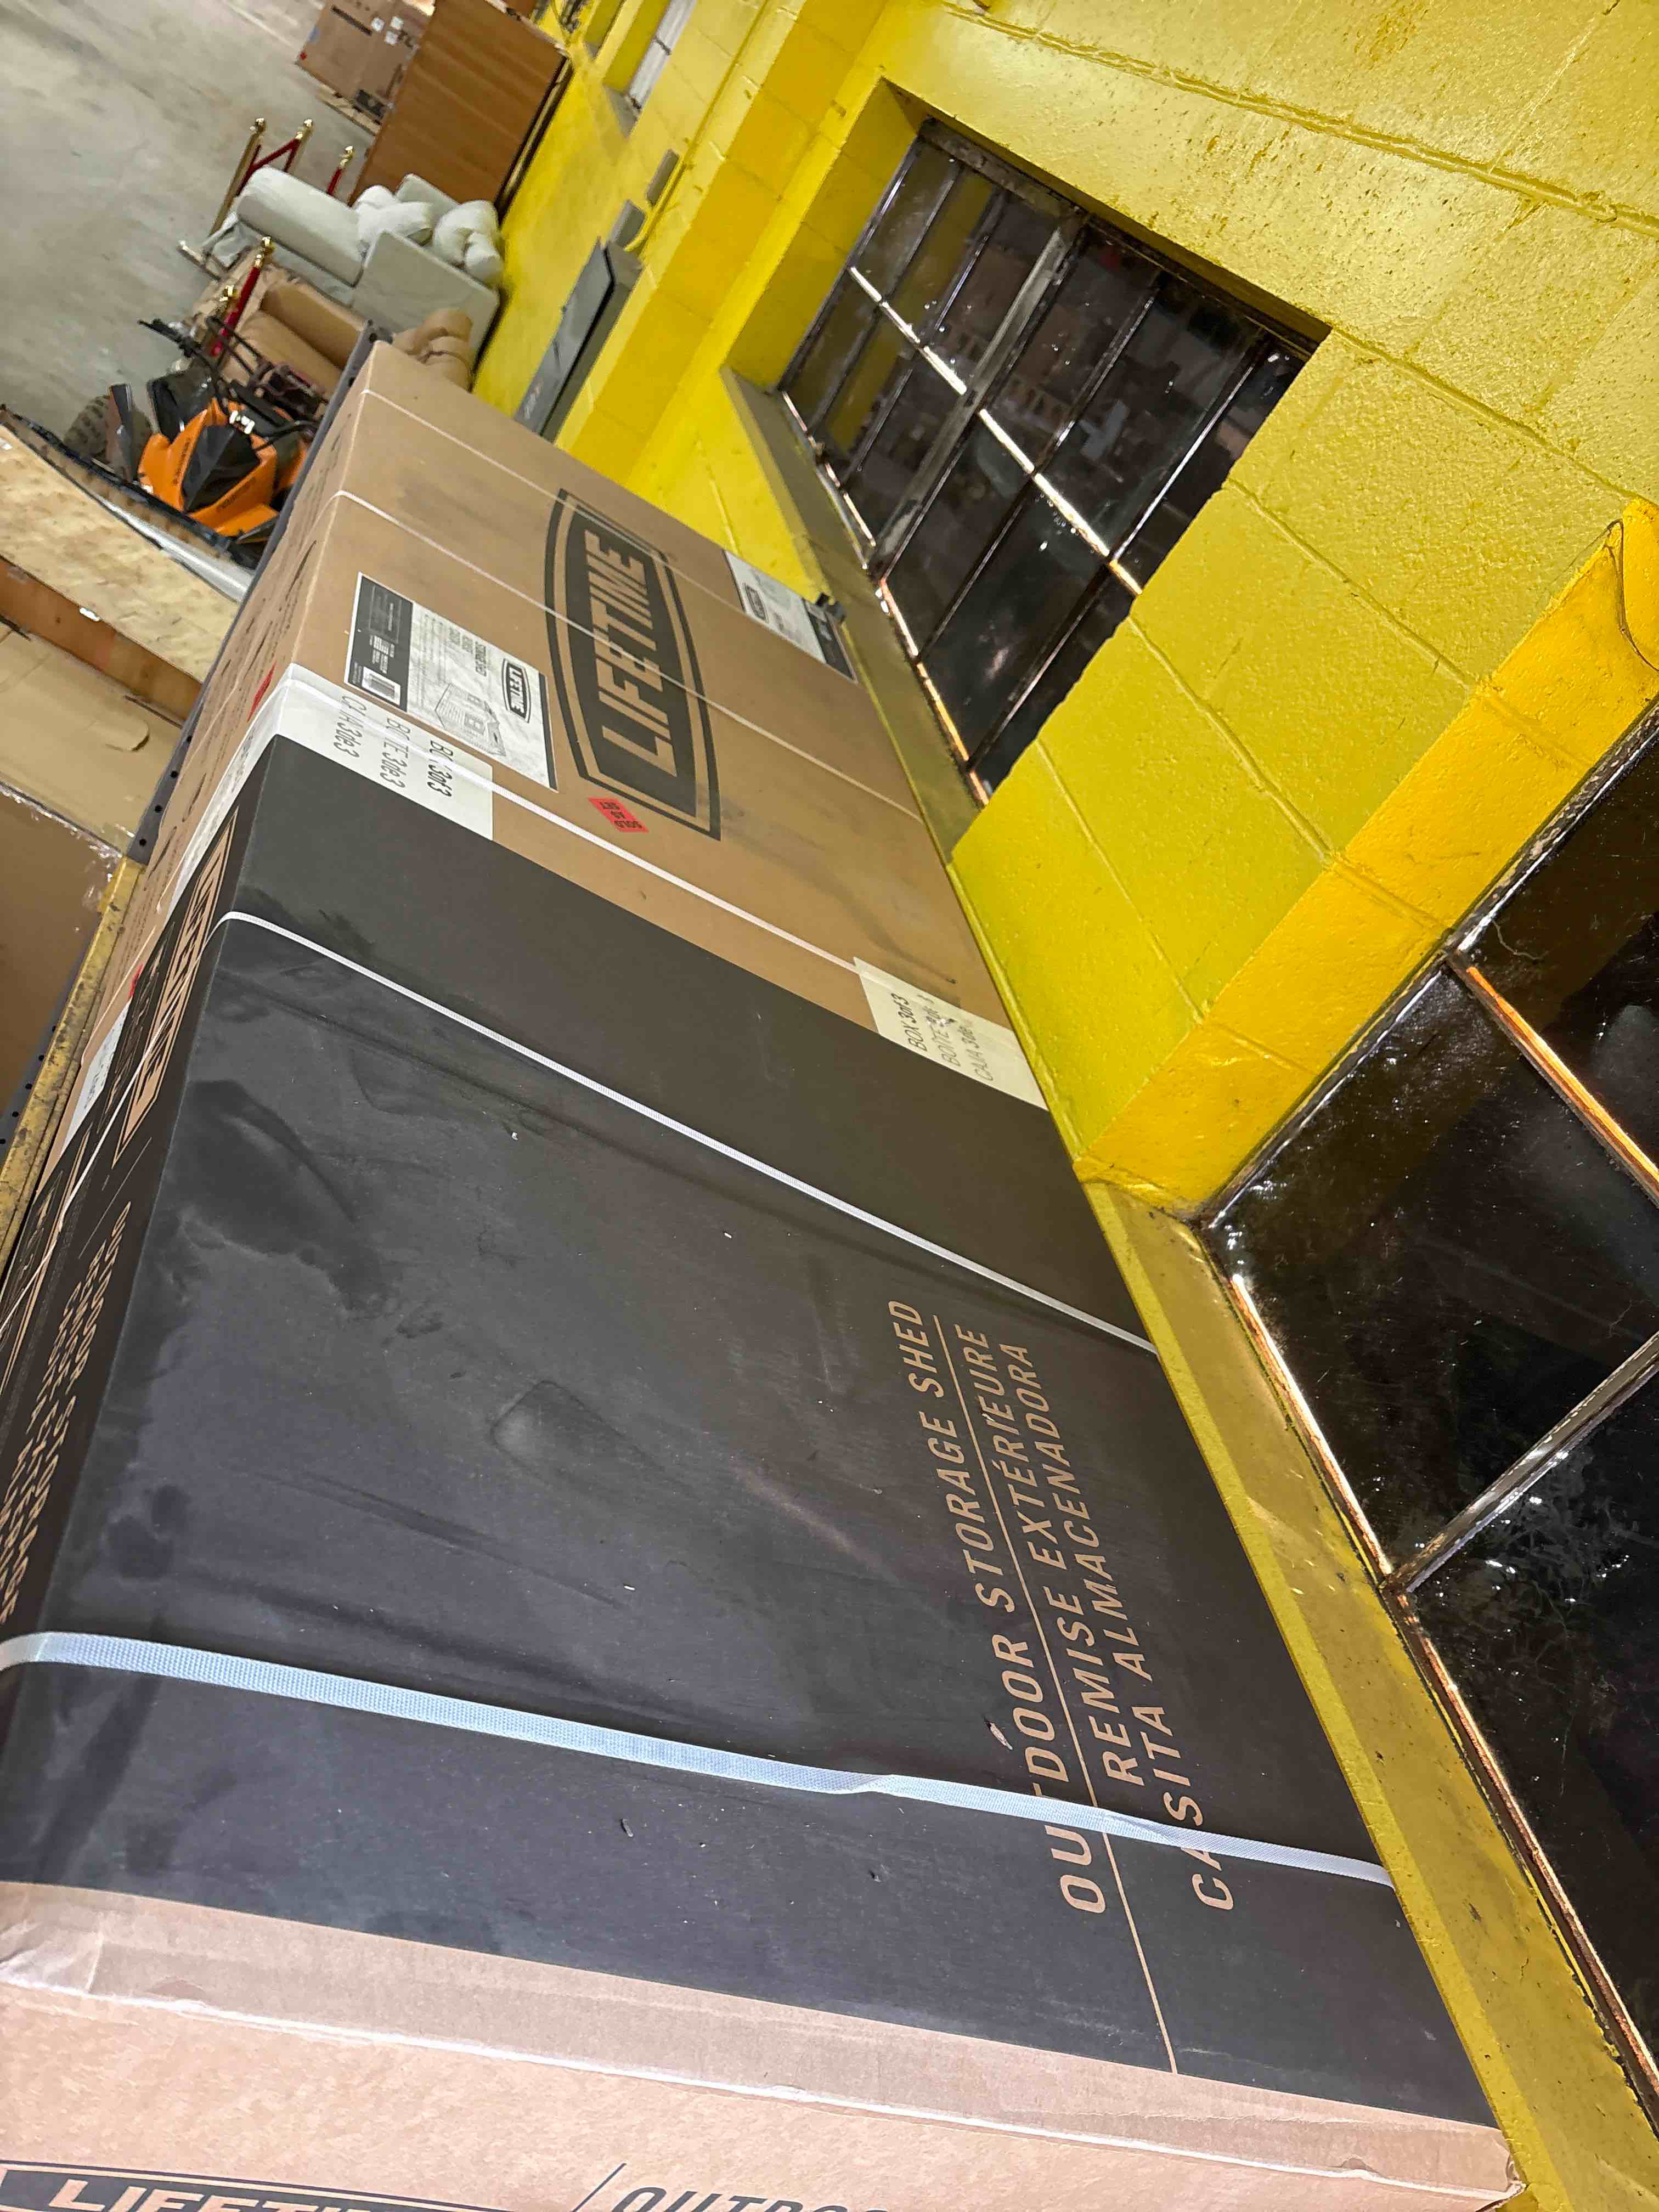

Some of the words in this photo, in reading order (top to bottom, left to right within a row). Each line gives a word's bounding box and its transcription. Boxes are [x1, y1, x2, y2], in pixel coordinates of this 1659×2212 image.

[584, 529, 677, 777] LIFETIME
[137, 851, 221, 1106] LIFETIME
[901, 1020, 928, 1052] BOX
[26, 1281, 82, 1435] CASITA
[49, 1240, 106, 1402] REMISE
[66, 1201, 132, 1396] OUTDOOR
[888, 1301, 944, 1398] SHED
[0, 1395, 77, 1624] STORAGE
[918, 1410, 1015, 1613] STORAGE
[954, 1324, 1067, 1570] EXTÉRIEURE
[1000, 1344, 1153, 1682] ALMACENADORA
[992, 1634, 1107, 1914] OUDOOR
[1043, 1585, 1145, 1786] REMISE
